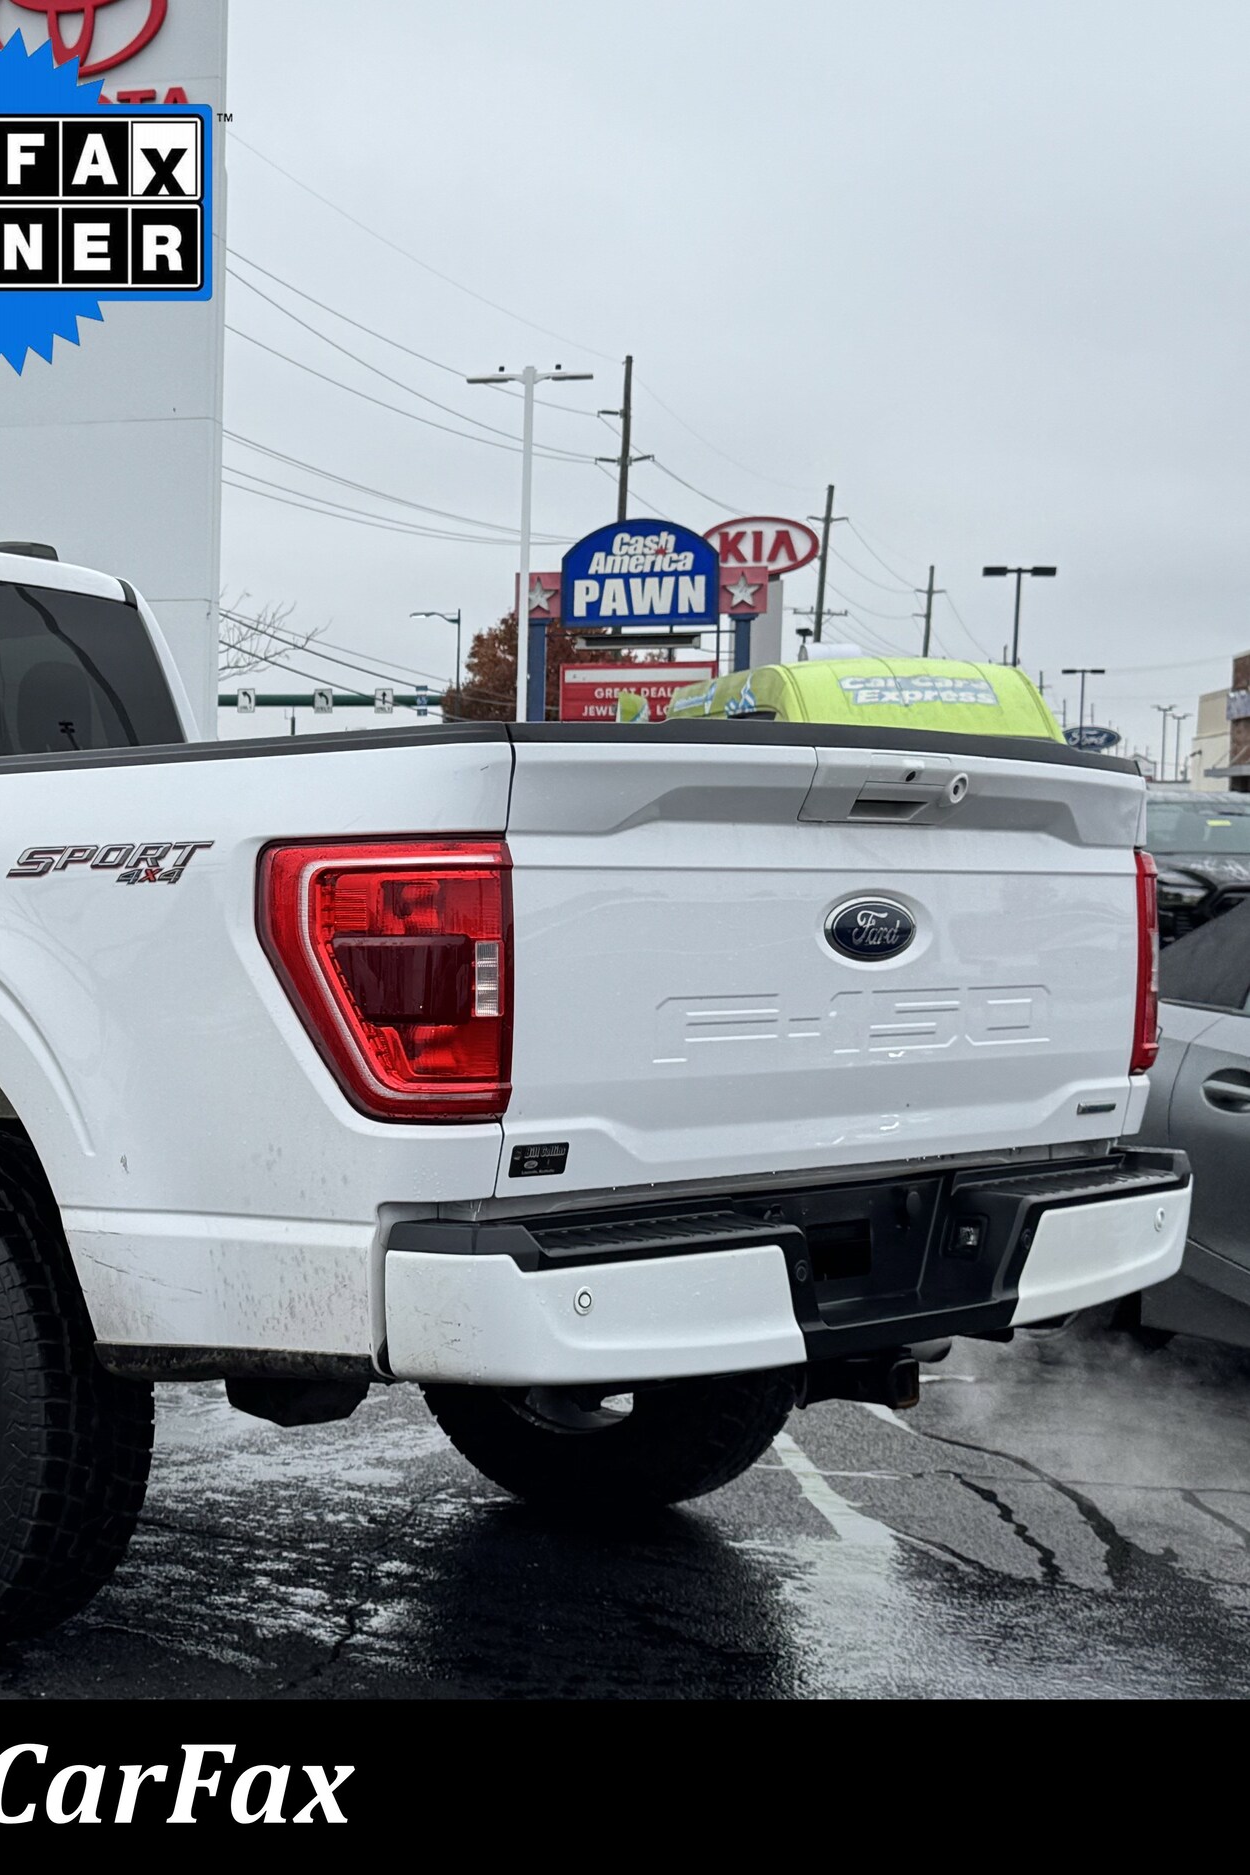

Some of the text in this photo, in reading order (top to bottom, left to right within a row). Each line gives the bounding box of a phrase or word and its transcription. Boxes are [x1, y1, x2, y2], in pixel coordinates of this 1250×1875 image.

[612, 531, 676, 555] Cash
[718, 530, 797, 563] KIA
[588, 551, 694, 574] America
[573, 575, 706, 617] PAWN
[641, 687, 679, 698] DEAL
[856, 689, 997, 704] Express
[6, 840, 215, 878] SPORT
[851, 910, 900, 946] Ford
